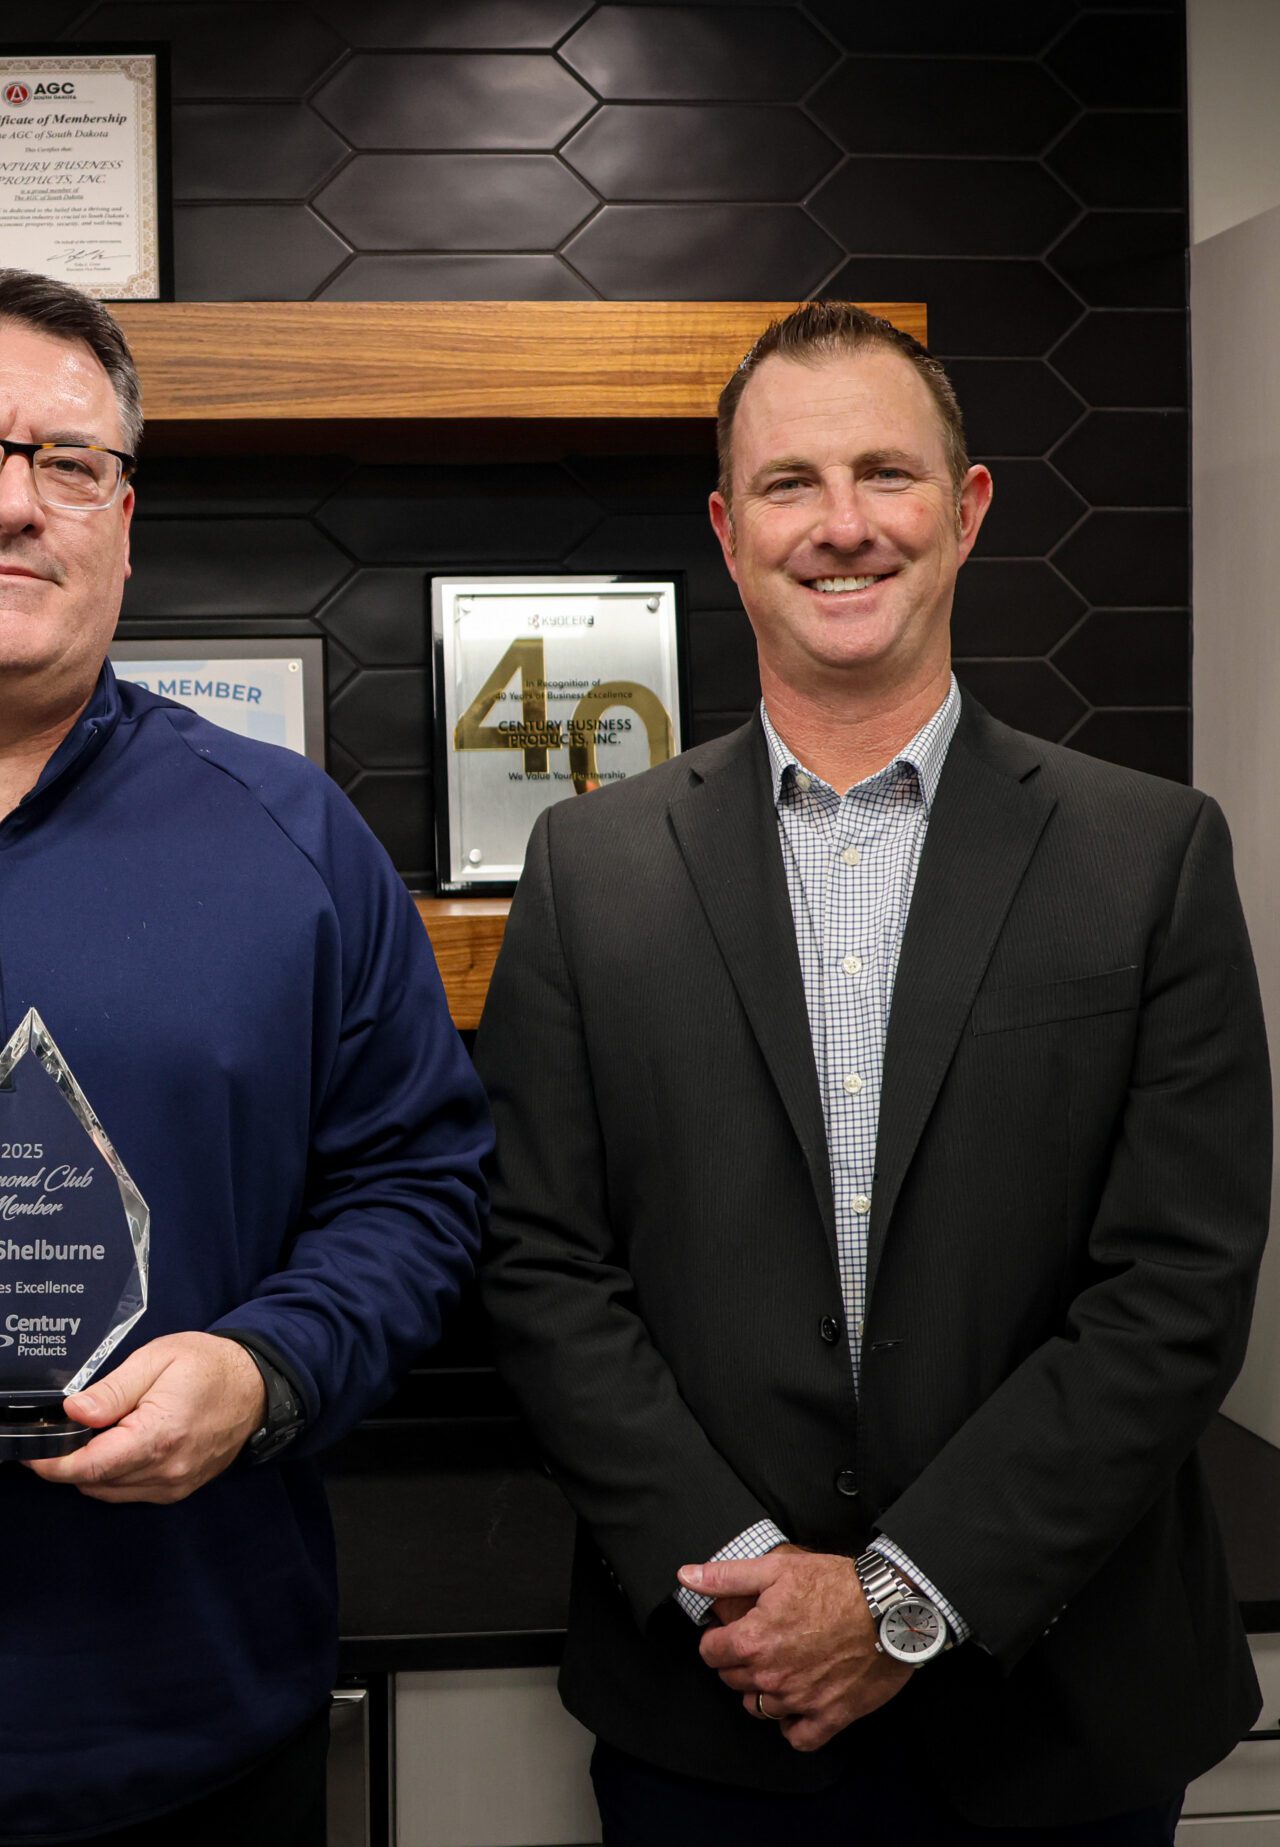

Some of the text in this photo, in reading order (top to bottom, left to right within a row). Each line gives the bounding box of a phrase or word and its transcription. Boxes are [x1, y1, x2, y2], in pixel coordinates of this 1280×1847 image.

[33, 82, 75, 95] AGC
[36, 114, 51, 127] of
[52, 113, 127, 125] Membership
[9, 131, 34, 139] AGC
[34, 131, 46, 140] of
[46, 130, 72, 139] South
[74, 130, 109, 138] Dakota
[54, 160, 123, 170] BUSINESS
[526, 679, 601, 689] In Recognition of
[158, 680, 262, 704] MEMBER
[547, 691, 584, 700] Business
[587, 690, 633, 700] Excellence
[498, 719, 632, 732] CENTURY BUSINESS
[510, 733, 621, 746] PRODUCTS, INC.
[509, 771, 626, 781] We Value Your Partnership
[1, 1143, 43, 1159] 2025
[44, 1165, 94, 1192] Club
[15, 1281, 84, 1294] Excellence
[5, 1314, 81, 1335] Century
[19, 1333, 66, 1344] Business
[17, 1345, 67, 1356] Products
